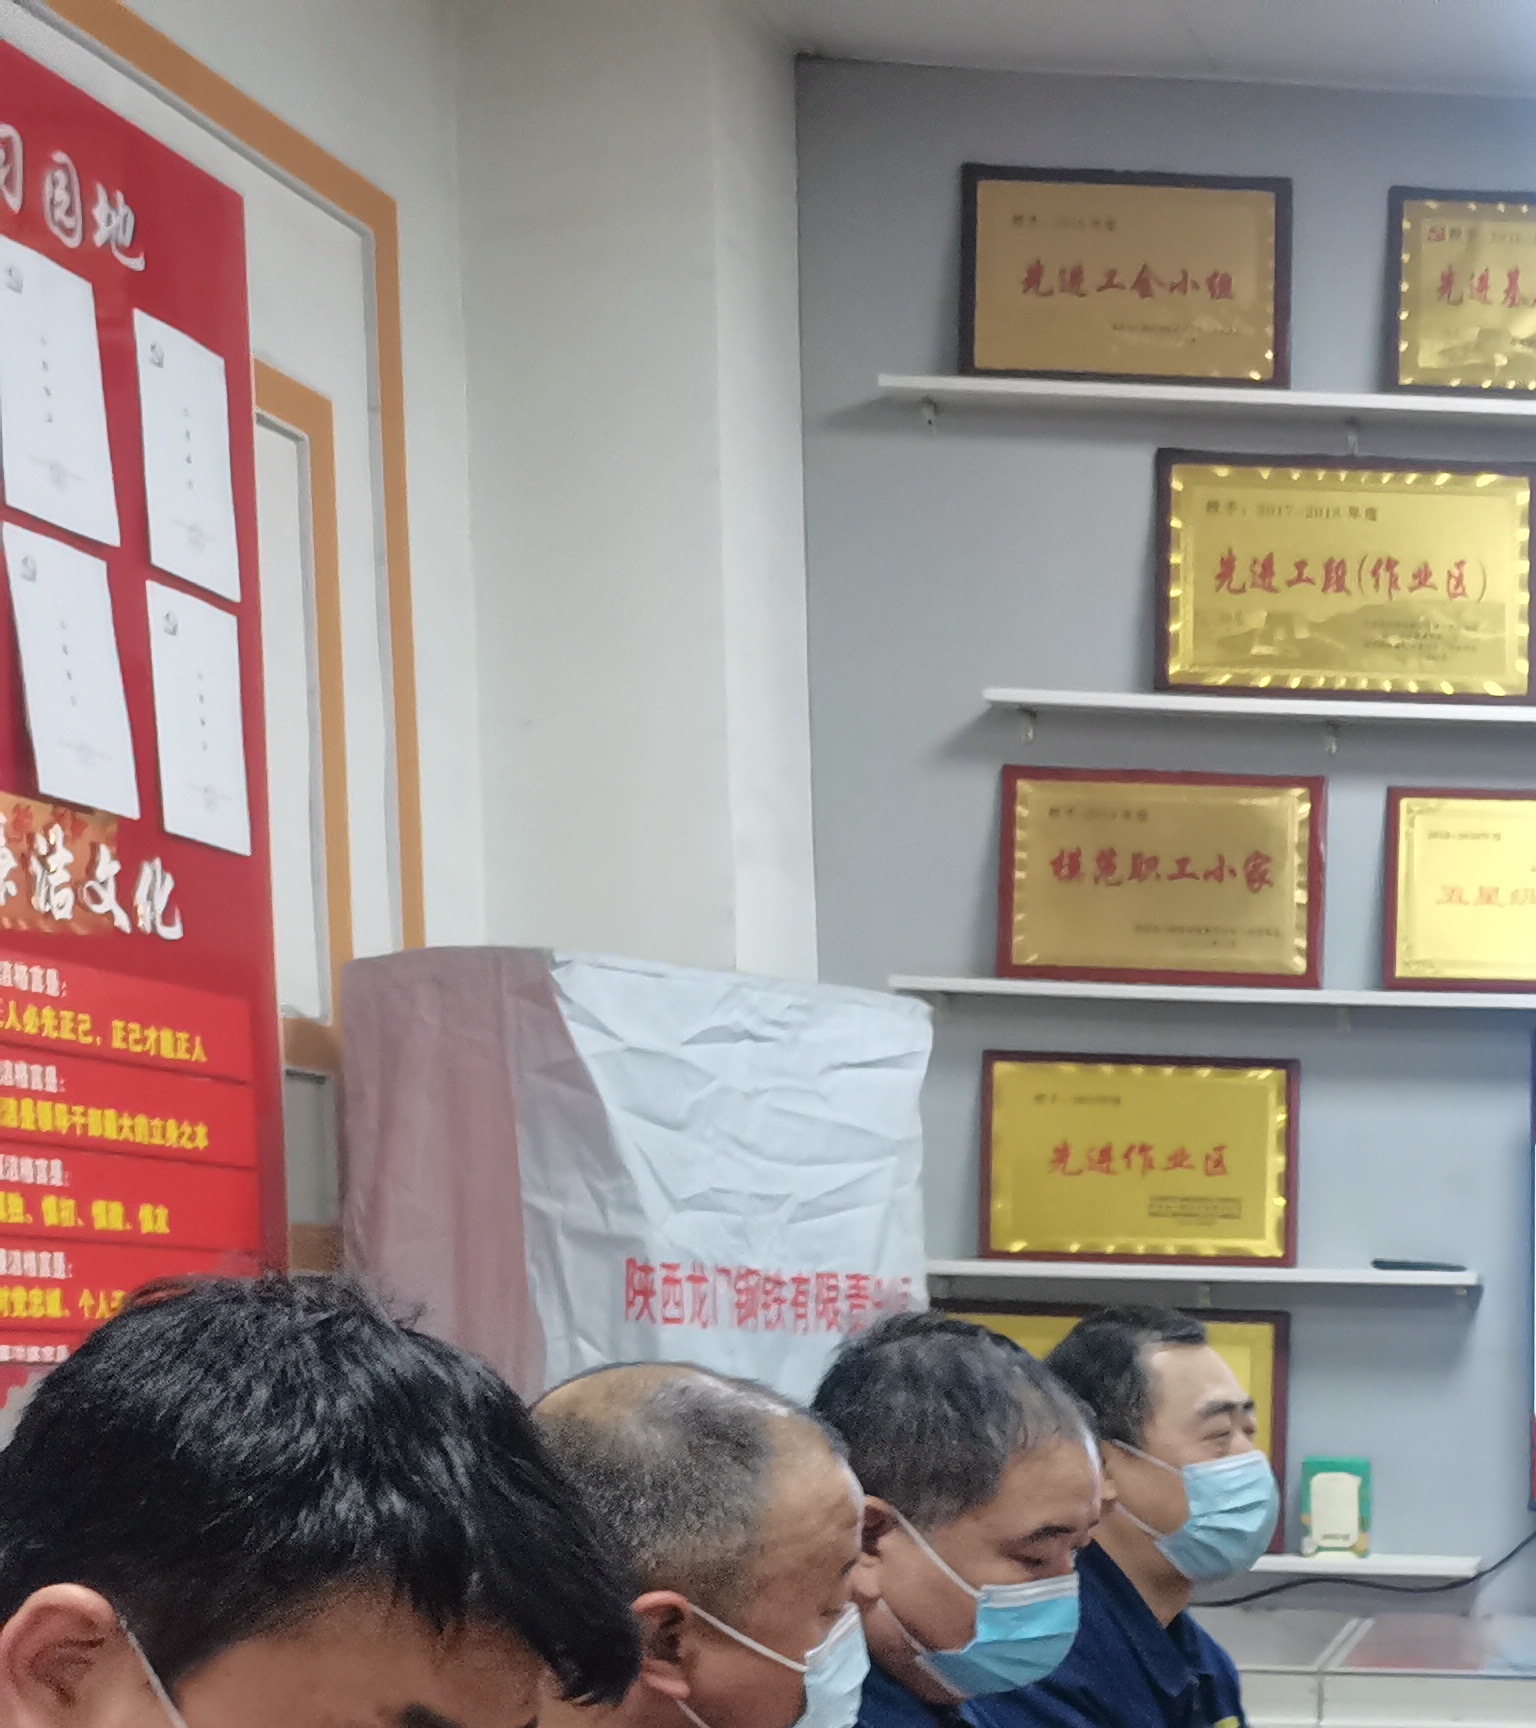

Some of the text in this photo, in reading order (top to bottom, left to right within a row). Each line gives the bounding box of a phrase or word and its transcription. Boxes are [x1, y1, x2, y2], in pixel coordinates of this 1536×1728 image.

[1050, 847, 1274, 893] 模范职工小家
[1049, 1139, 1228, 1177] 先进作业区
